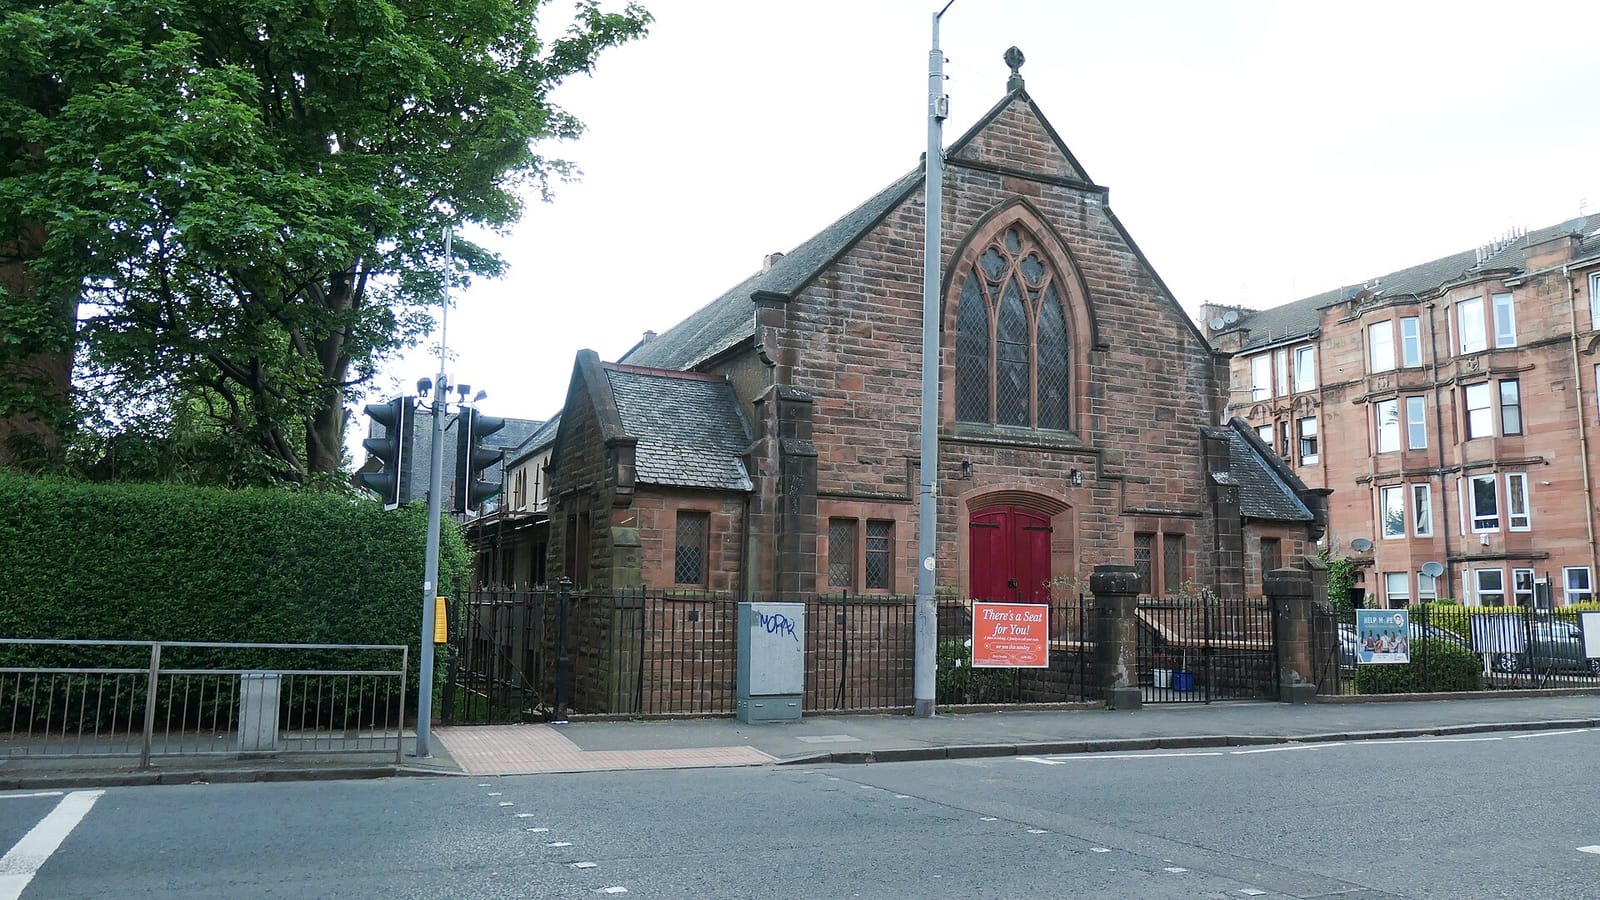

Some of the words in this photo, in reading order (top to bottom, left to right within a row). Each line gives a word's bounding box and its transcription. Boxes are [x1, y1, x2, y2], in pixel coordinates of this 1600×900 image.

[983, 609, 1013, 621] There's
[1015, 614, 1022, 622] a
[1023, 611, 1042, 623] Seat
[1364, 616, 1377, 624] HELP
[992, 623, 1008, 637] for
[1010, 624, 1030, 635] You!
